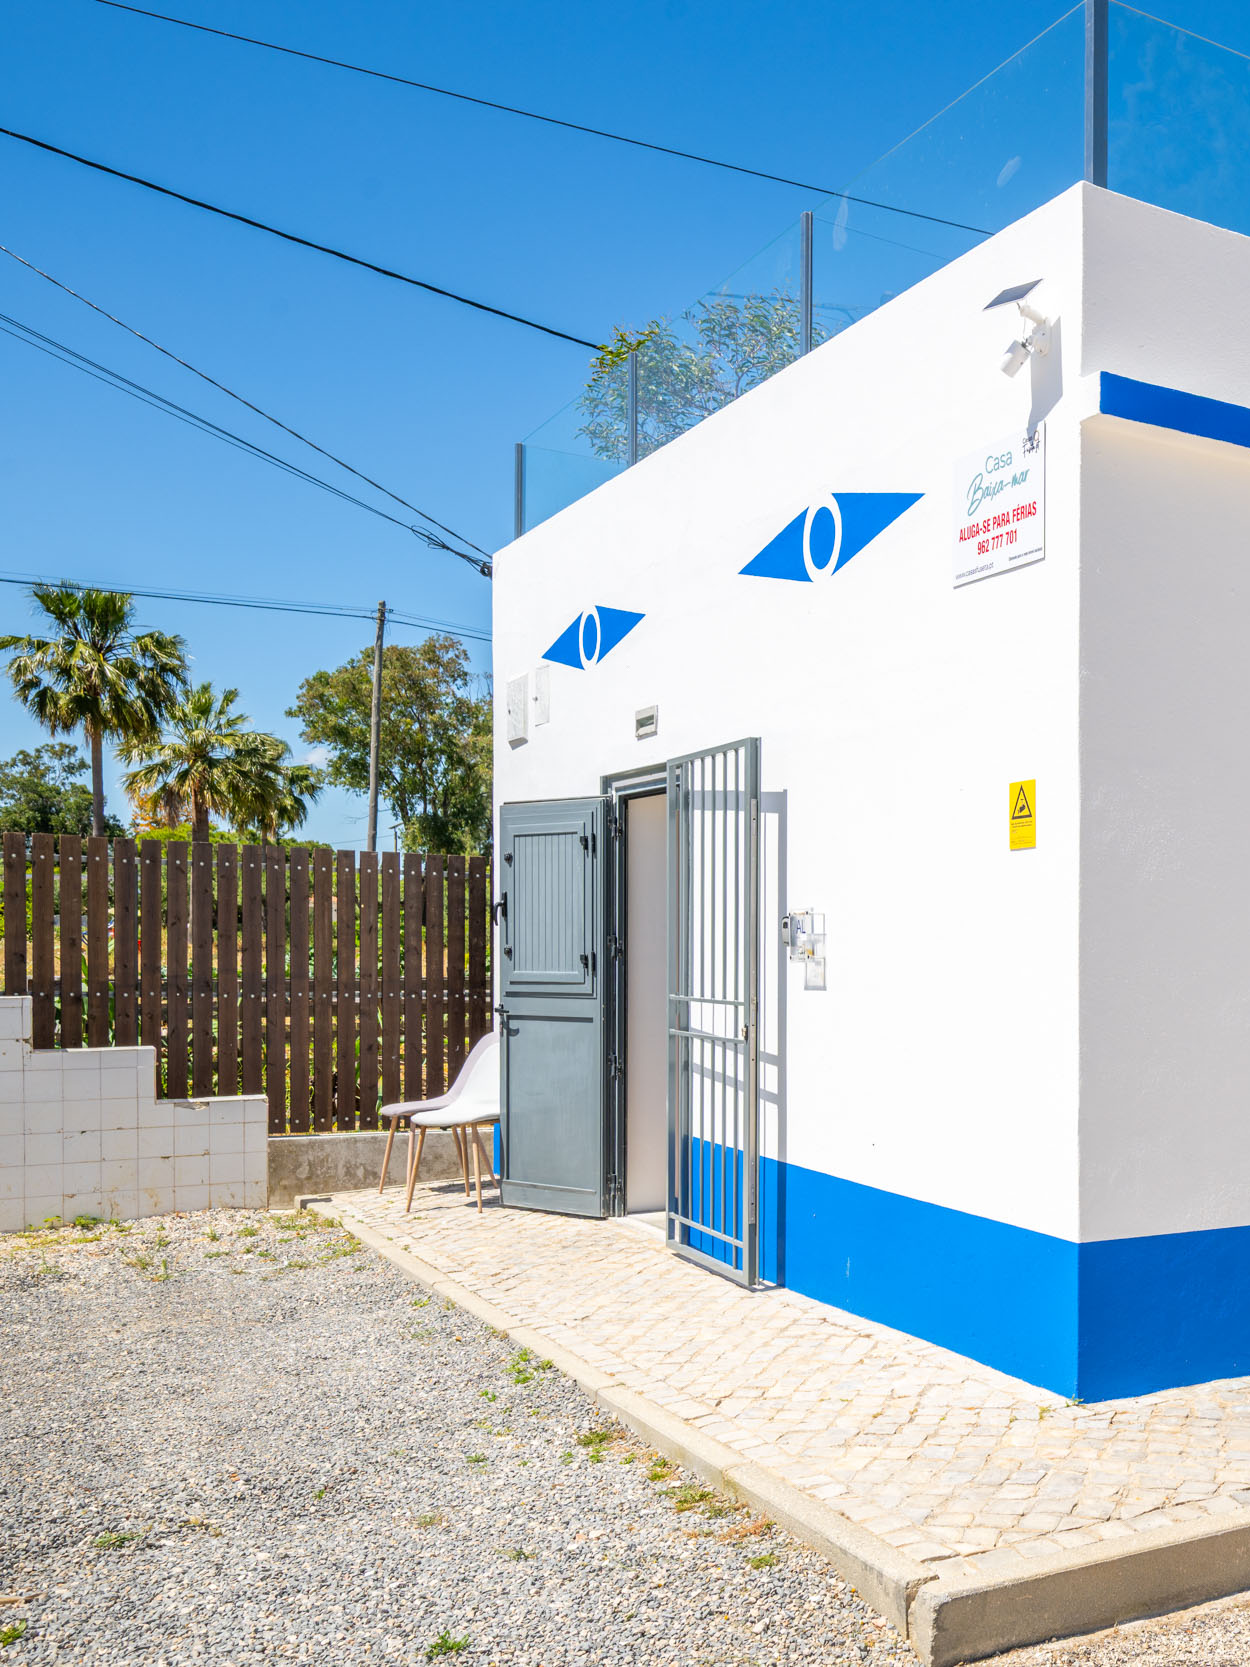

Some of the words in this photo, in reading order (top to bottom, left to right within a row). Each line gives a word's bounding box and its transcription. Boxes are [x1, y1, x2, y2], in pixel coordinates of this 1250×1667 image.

[985, 451, 1013, 474] Casa
[967, 468, 1030, 517] Baixa-mar
[959, 519, 991, 543] ALUGA-SE
[992, 511, 1010, 530] PARA
[1012, 500, 1037, 523] FÉRIAS
[977, 538, 990, 556] 962
[991, 533, 1004, 551] 777
[1005, 527, 1018, 546] 701
[796, 919, 807, 934] AL
